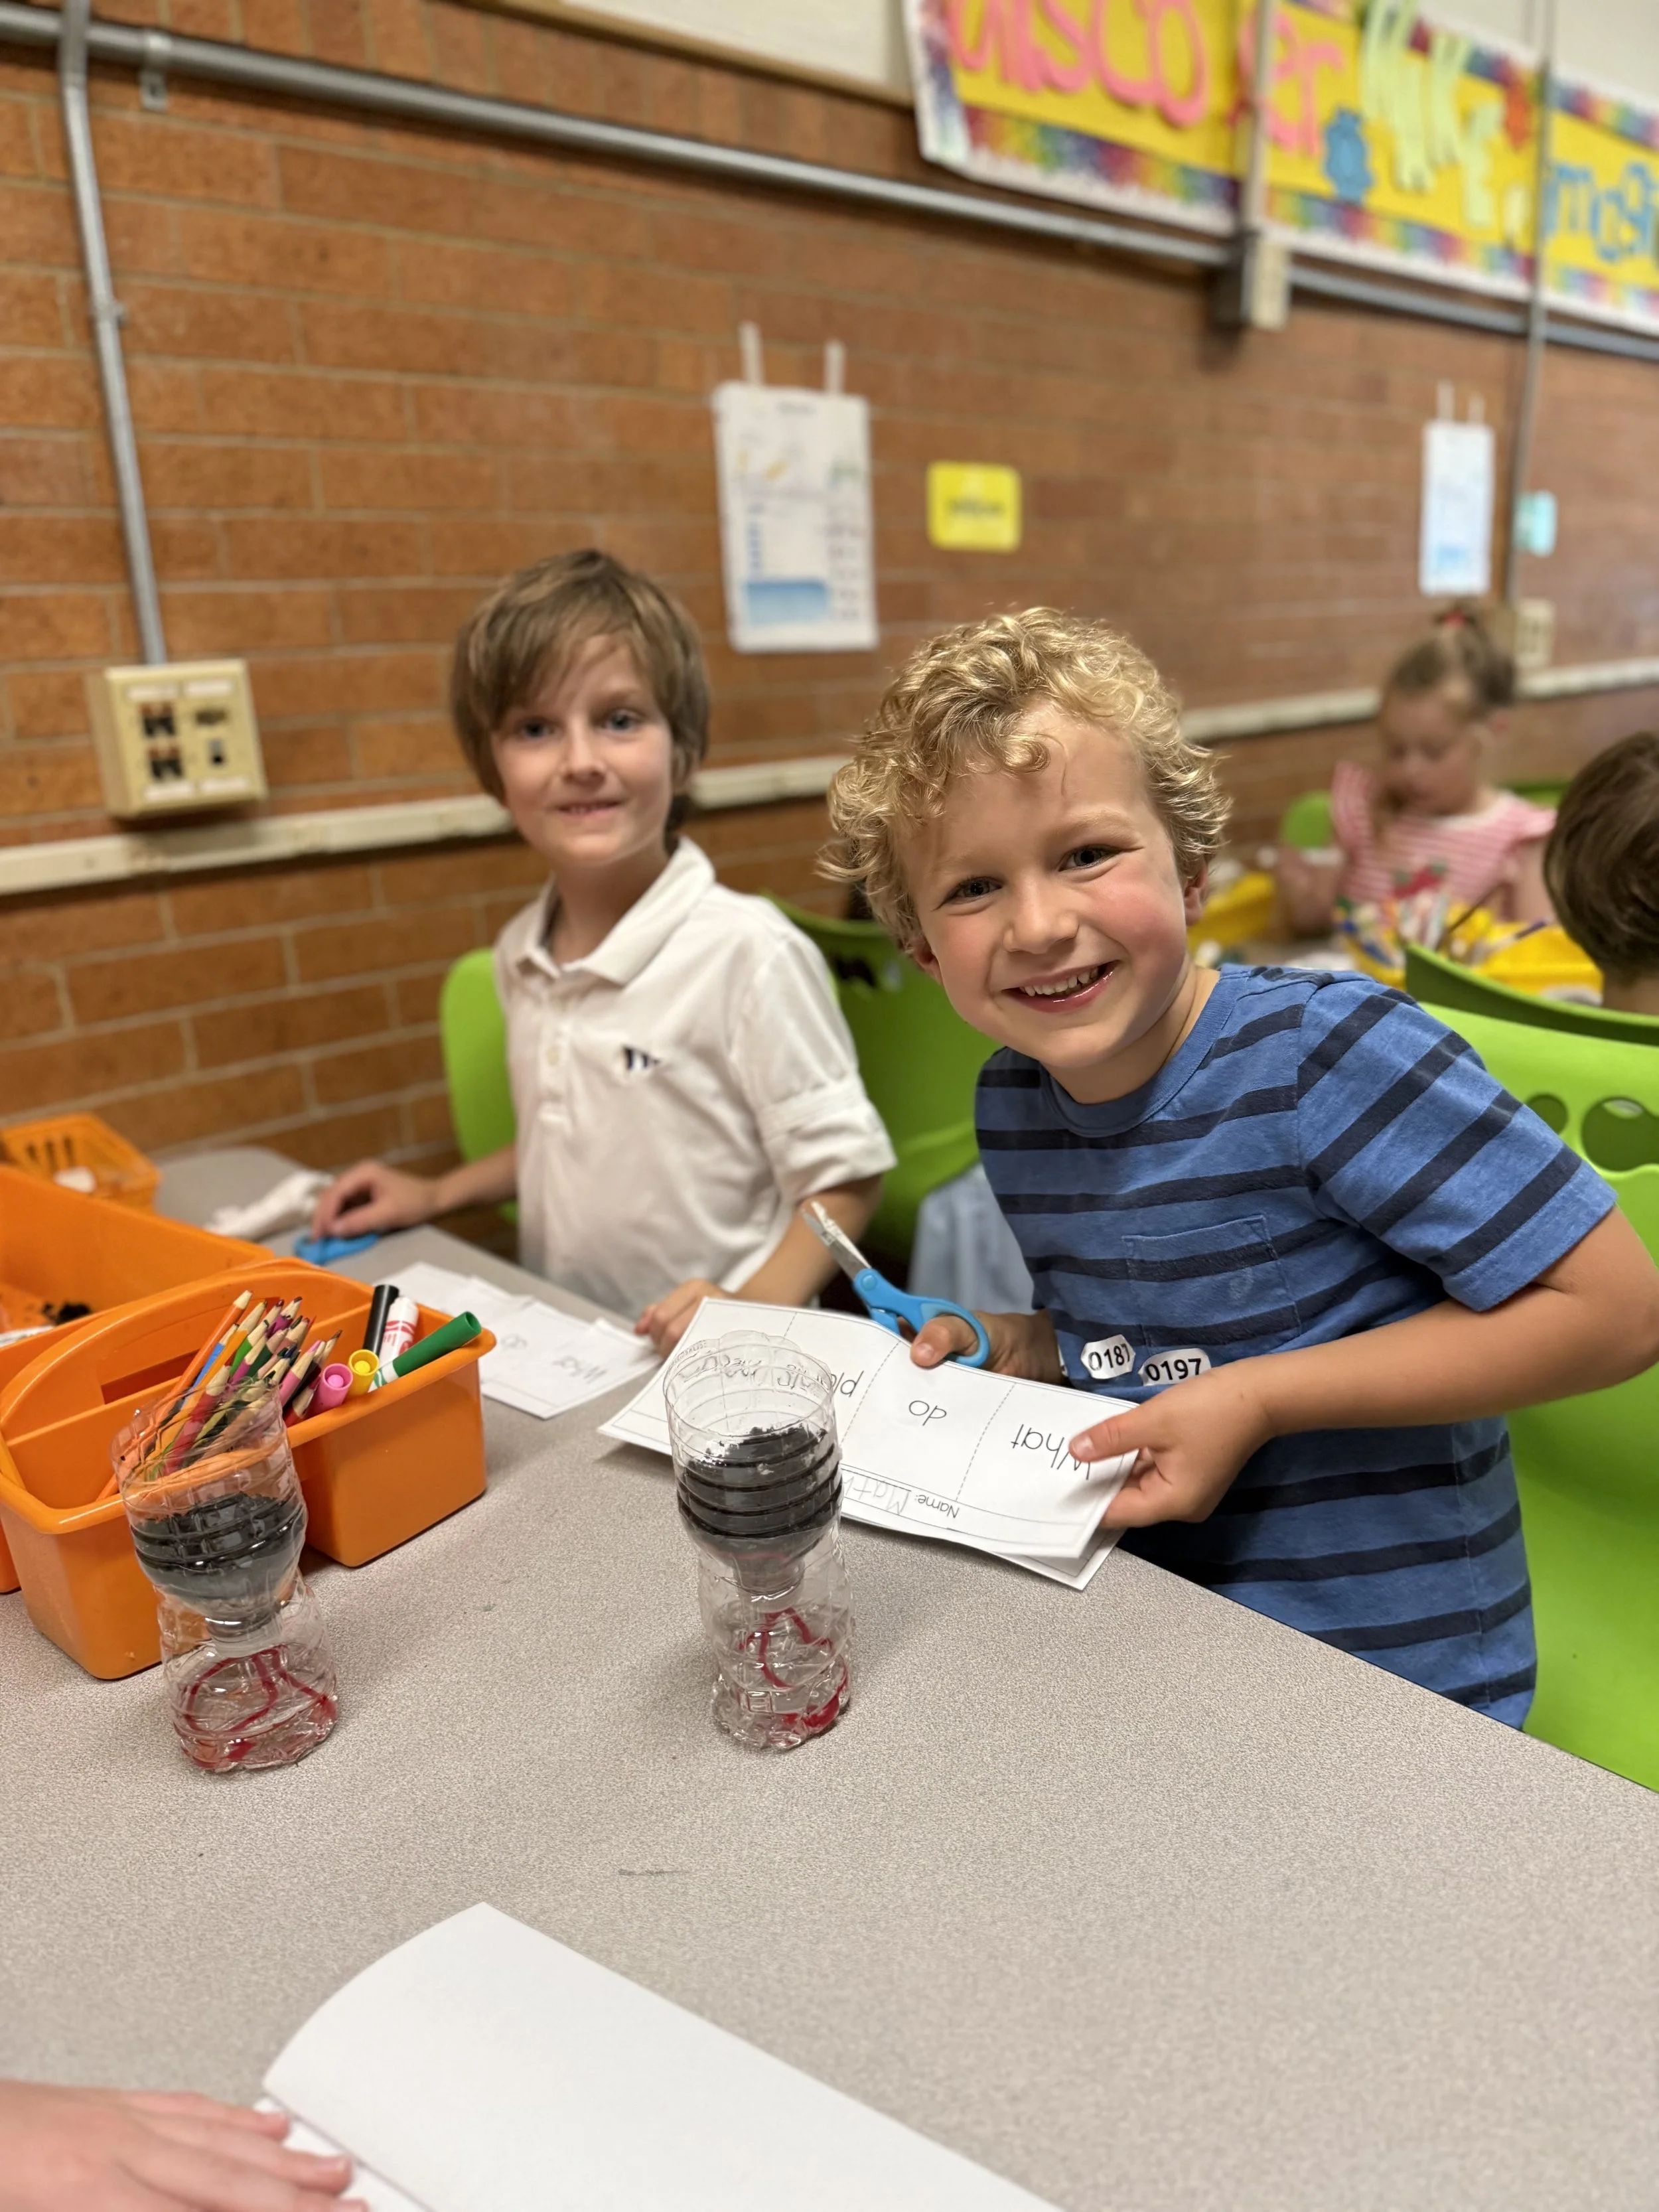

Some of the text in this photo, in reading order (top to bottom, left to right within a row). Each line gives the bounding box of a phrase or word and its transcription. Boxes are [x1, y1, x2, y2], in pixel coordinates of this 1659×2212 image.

[1088, 1343, 1131, 1371] 0187
[1144, 1358, 1202, 1381] 0197
[908, 1400, 947, 1426] do
[914, 1494, 960, 1518] Name:
